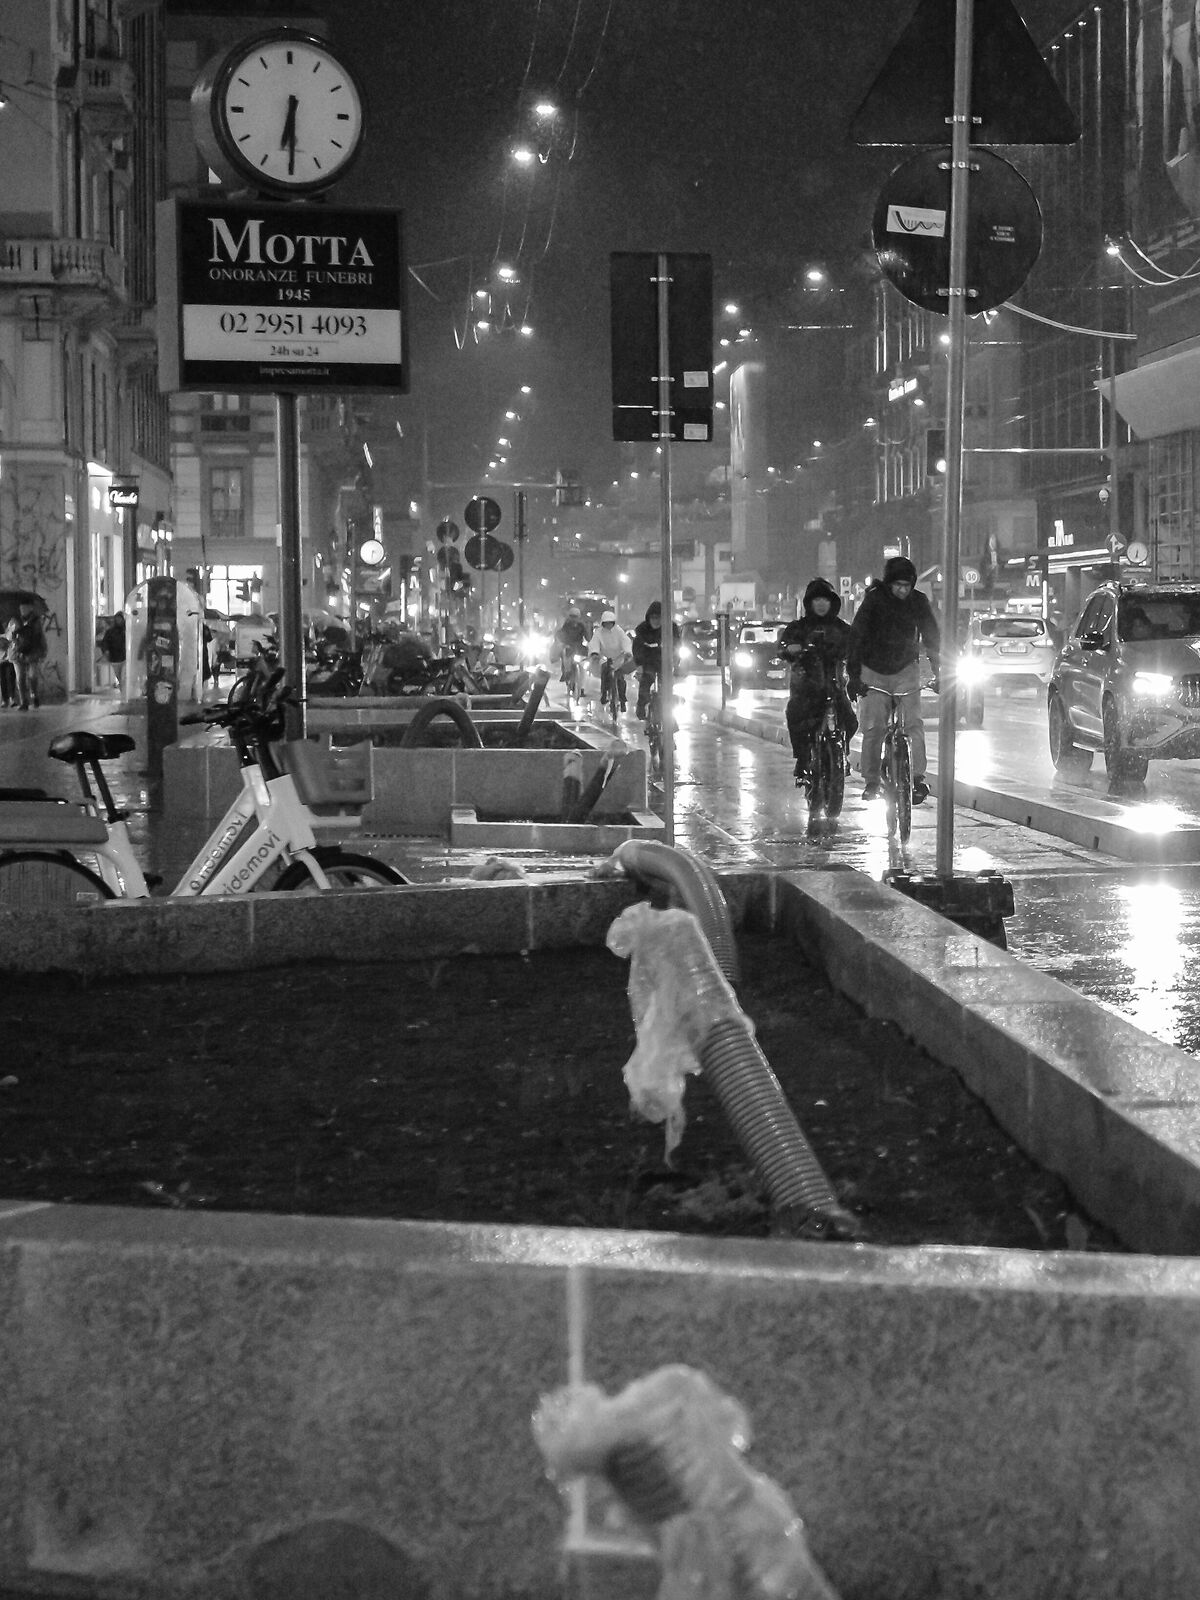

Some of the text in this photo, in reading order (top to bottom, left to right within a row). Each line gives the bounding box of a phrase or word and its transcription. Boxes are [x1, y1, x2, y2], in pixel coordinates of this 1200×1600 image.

[208, 217, 375, 267] MOTTA
[209, 267, 374, 285] ONORANZE FUNEBRI
[278, 288, 312, 301] 1945
[219, 312, 368, 337] 02 2951 4093
